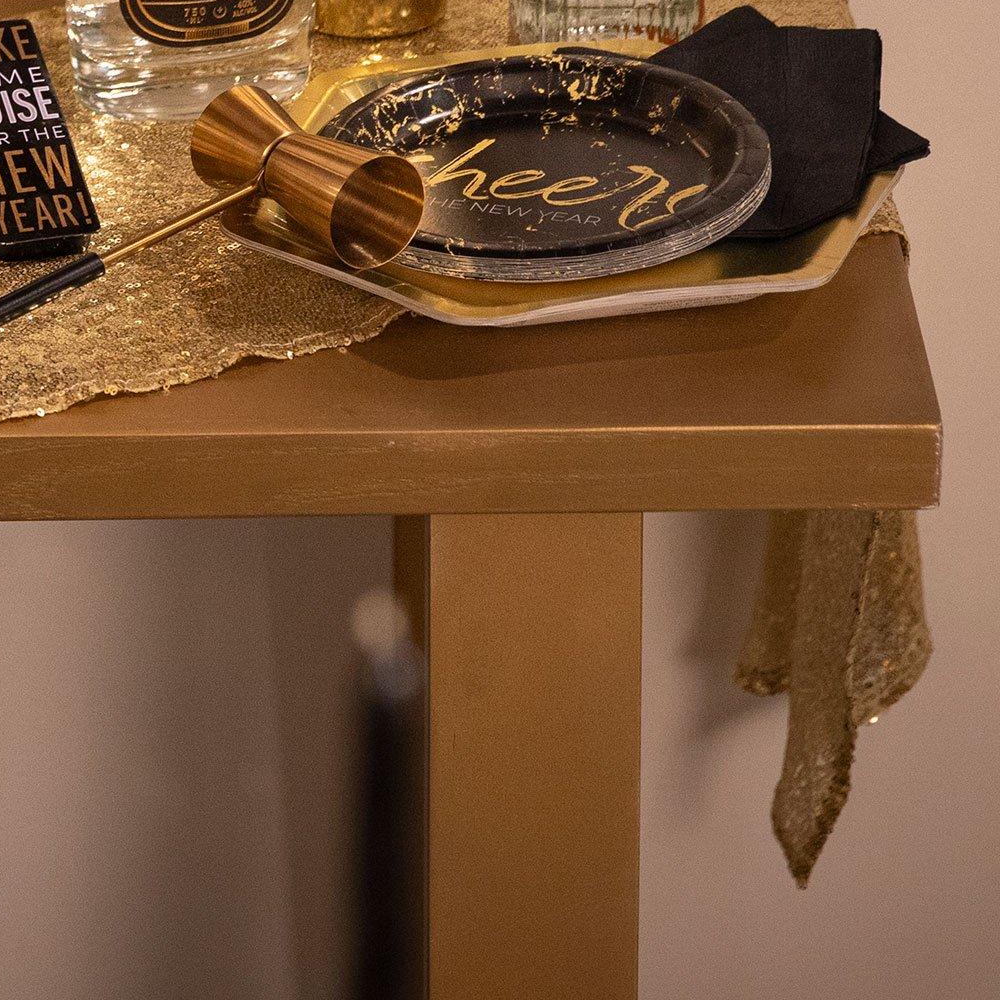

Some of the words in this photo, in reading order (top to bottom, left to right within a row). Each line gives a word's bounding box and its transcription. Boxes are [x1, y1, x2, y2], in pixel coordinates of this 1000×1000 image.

[184, 6, 206, 18] 750
[18, 125, 66, 142] THE
[406, 138, 708, 232] heers
[429, 197, 466, 208] HE
[469, 201, 533, 218] NEW
[538, 209, 602, 227] YEAR
